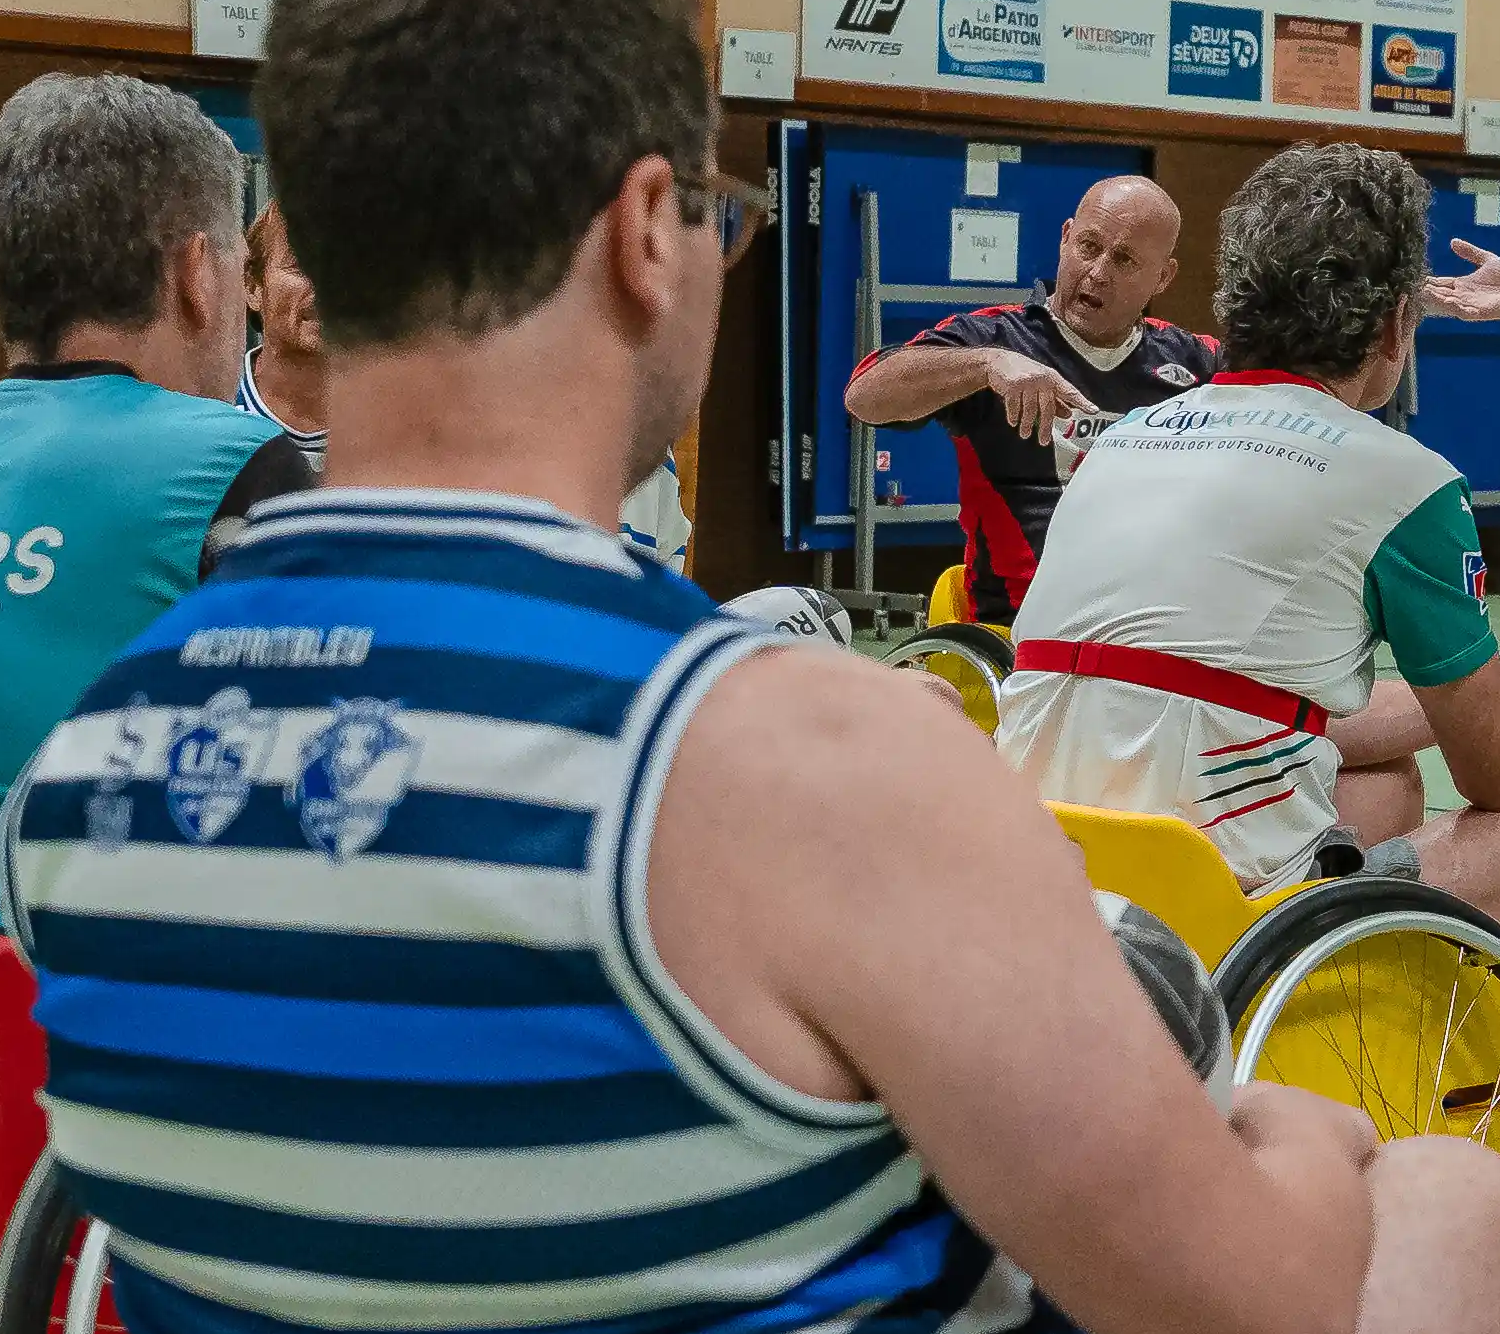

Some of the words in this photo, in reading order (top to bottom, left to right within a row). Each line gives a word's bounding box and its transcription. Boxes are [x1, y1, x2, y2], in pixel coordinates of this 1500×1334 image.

[221, 5, 260, 21] TABLE
[976, 8, 991, 23] Le
[238, 25, 245, 39] 5
[1075, 25, 1156, 49] INTERSPORT
[1190, 25, 1230, 46] DEUX
[824, 36, 904, 57] NANTES
[1172, 40, 1231, 65] SÈVRES
[744, 50, 774, 66] TABLE
[754, 69, 762, 81] 4
[808, 167, 821, 226] JOOLA
[1144, 399, 1350, 448] Capgemini
[1217, 439, 1328, 474] OUTSOURCING
